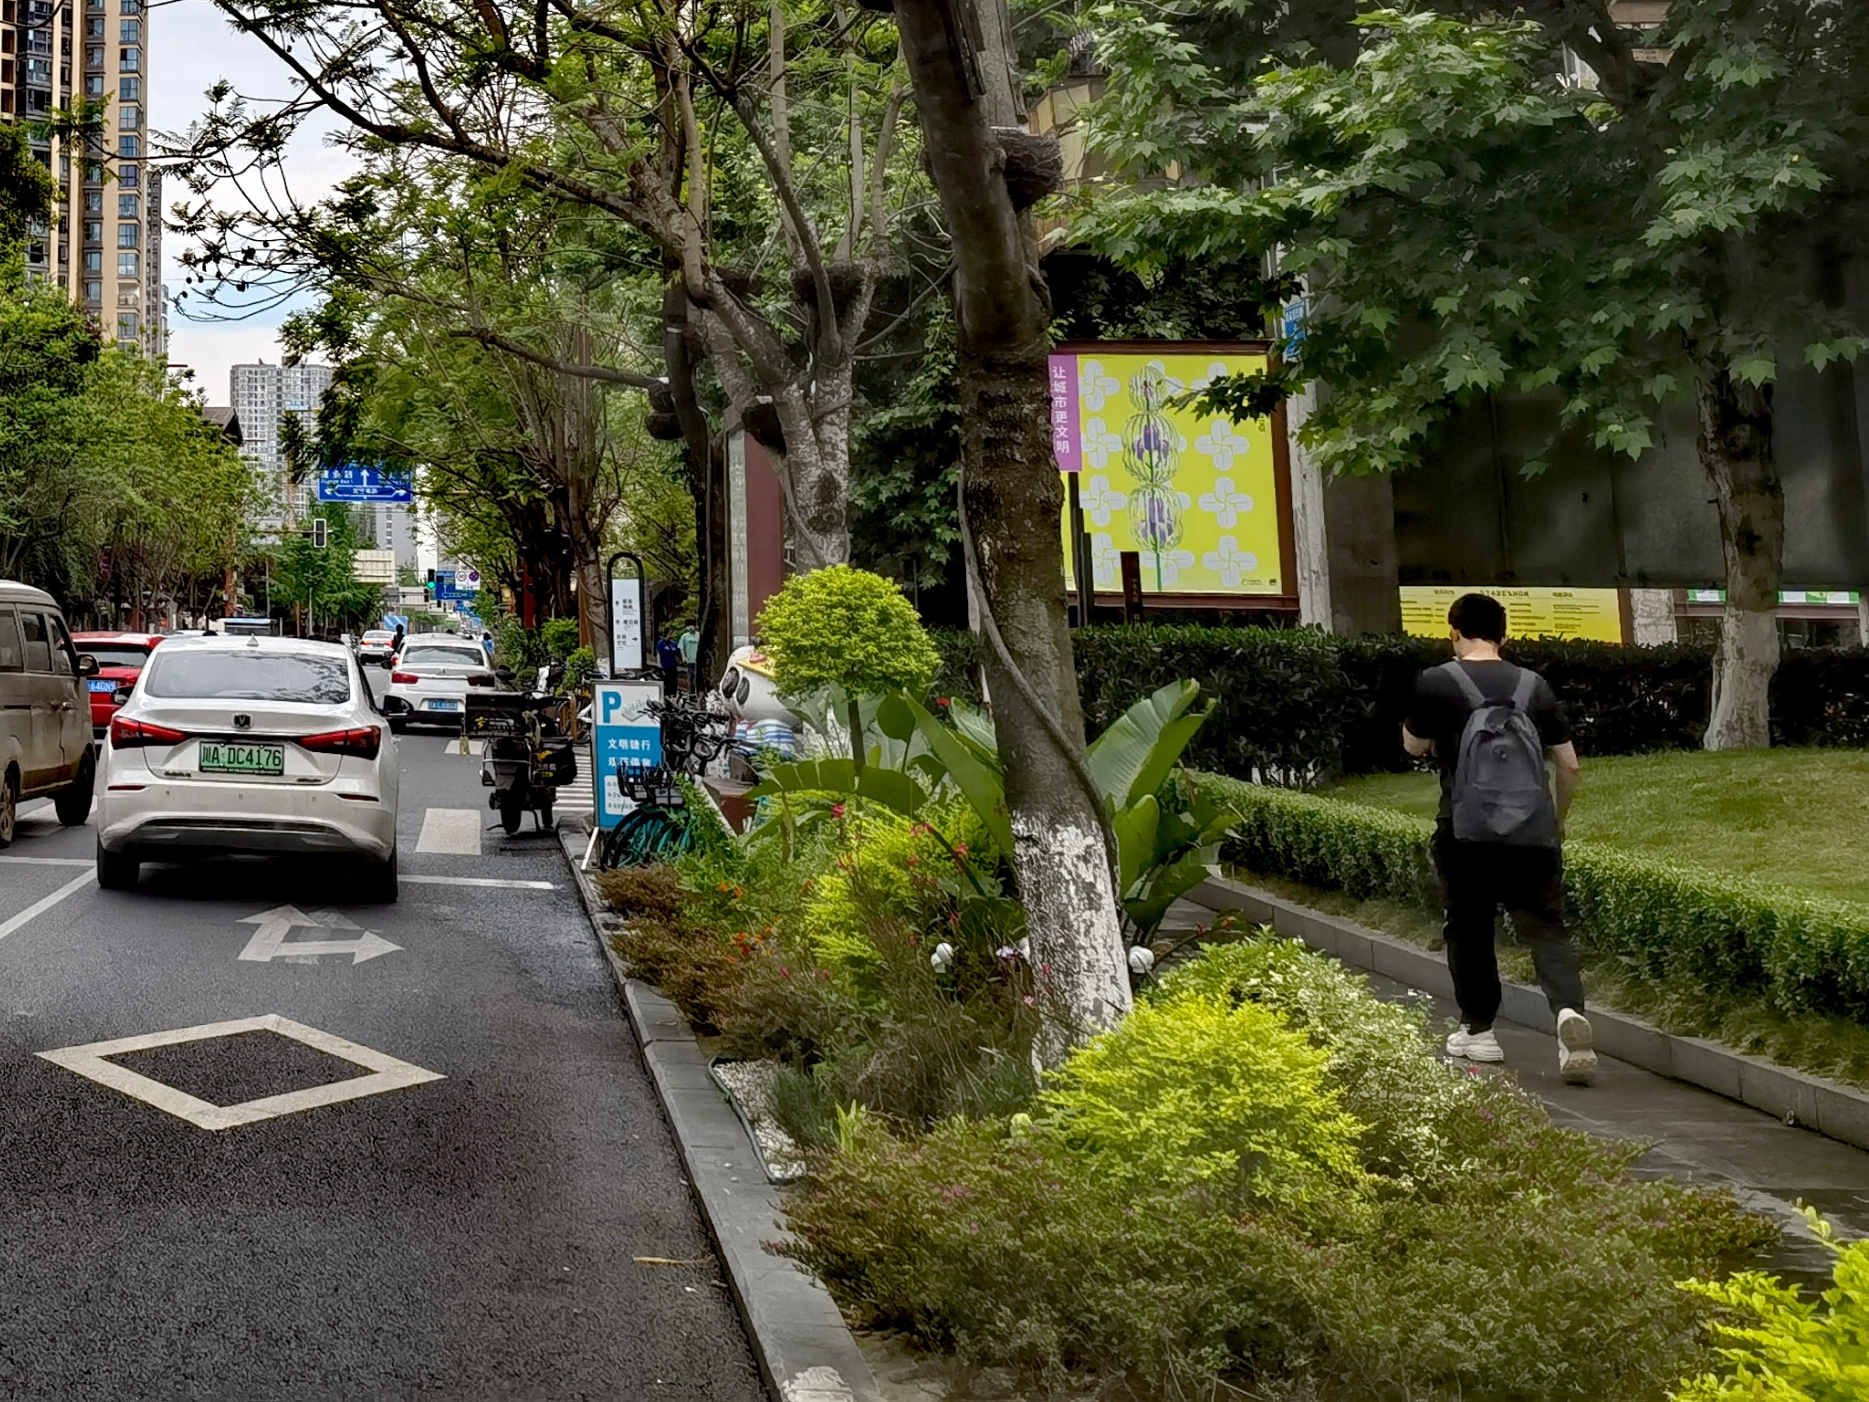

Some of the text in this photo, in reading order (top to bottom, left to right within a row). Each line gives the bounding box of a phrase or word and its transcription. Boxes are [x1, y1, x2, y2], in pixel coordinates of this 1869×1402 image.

[1052, 365, 1070, 454] 让城市更文明
[601, 691, 622, 724] P
